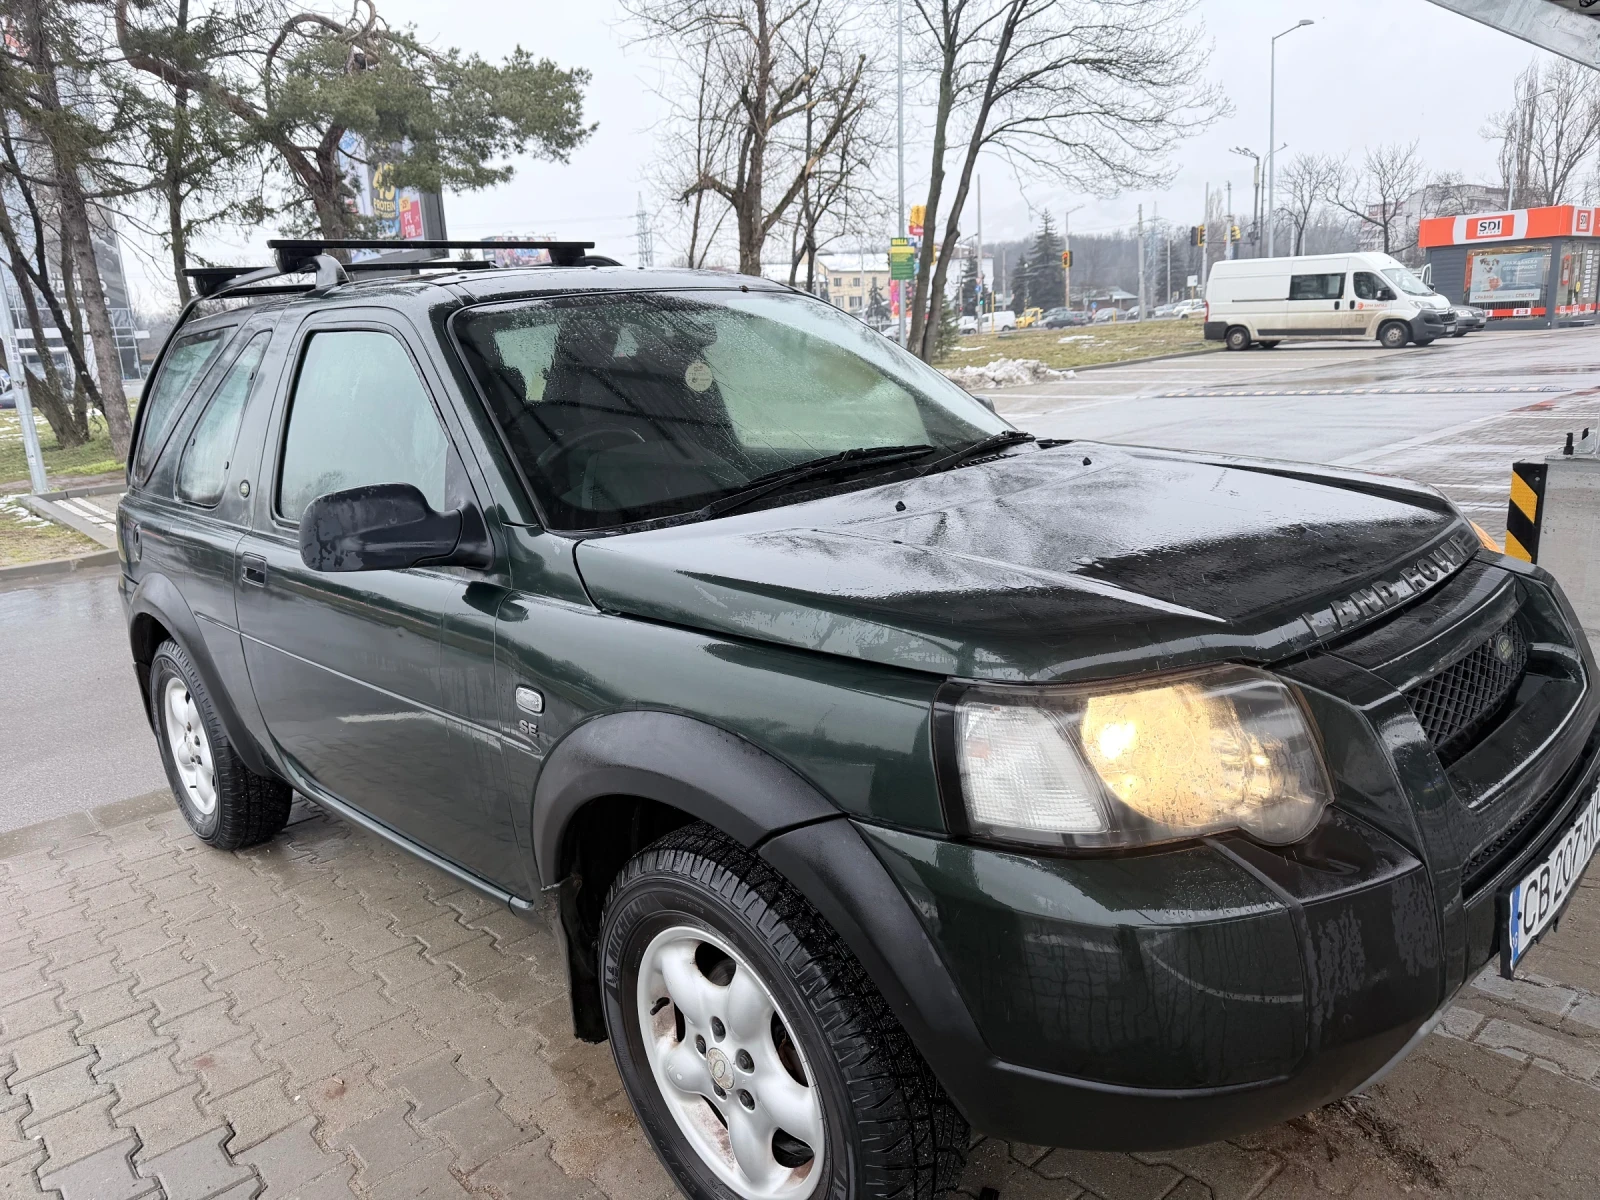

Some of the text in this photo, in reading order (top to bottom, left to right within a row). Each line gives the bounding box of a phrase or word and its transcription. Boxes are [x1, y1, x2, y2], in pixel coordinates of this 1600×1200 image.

[373, 198, 395, 211] PROTEIN
[1479, 220, 1501, 232] SDI
[1580, 214, 1588, 225] SDI
[1302, 531, 1471, 638] LAND ROVER
[519, 719, 540, 738] SE
[608, 893, 653, 963] MICHELIN
